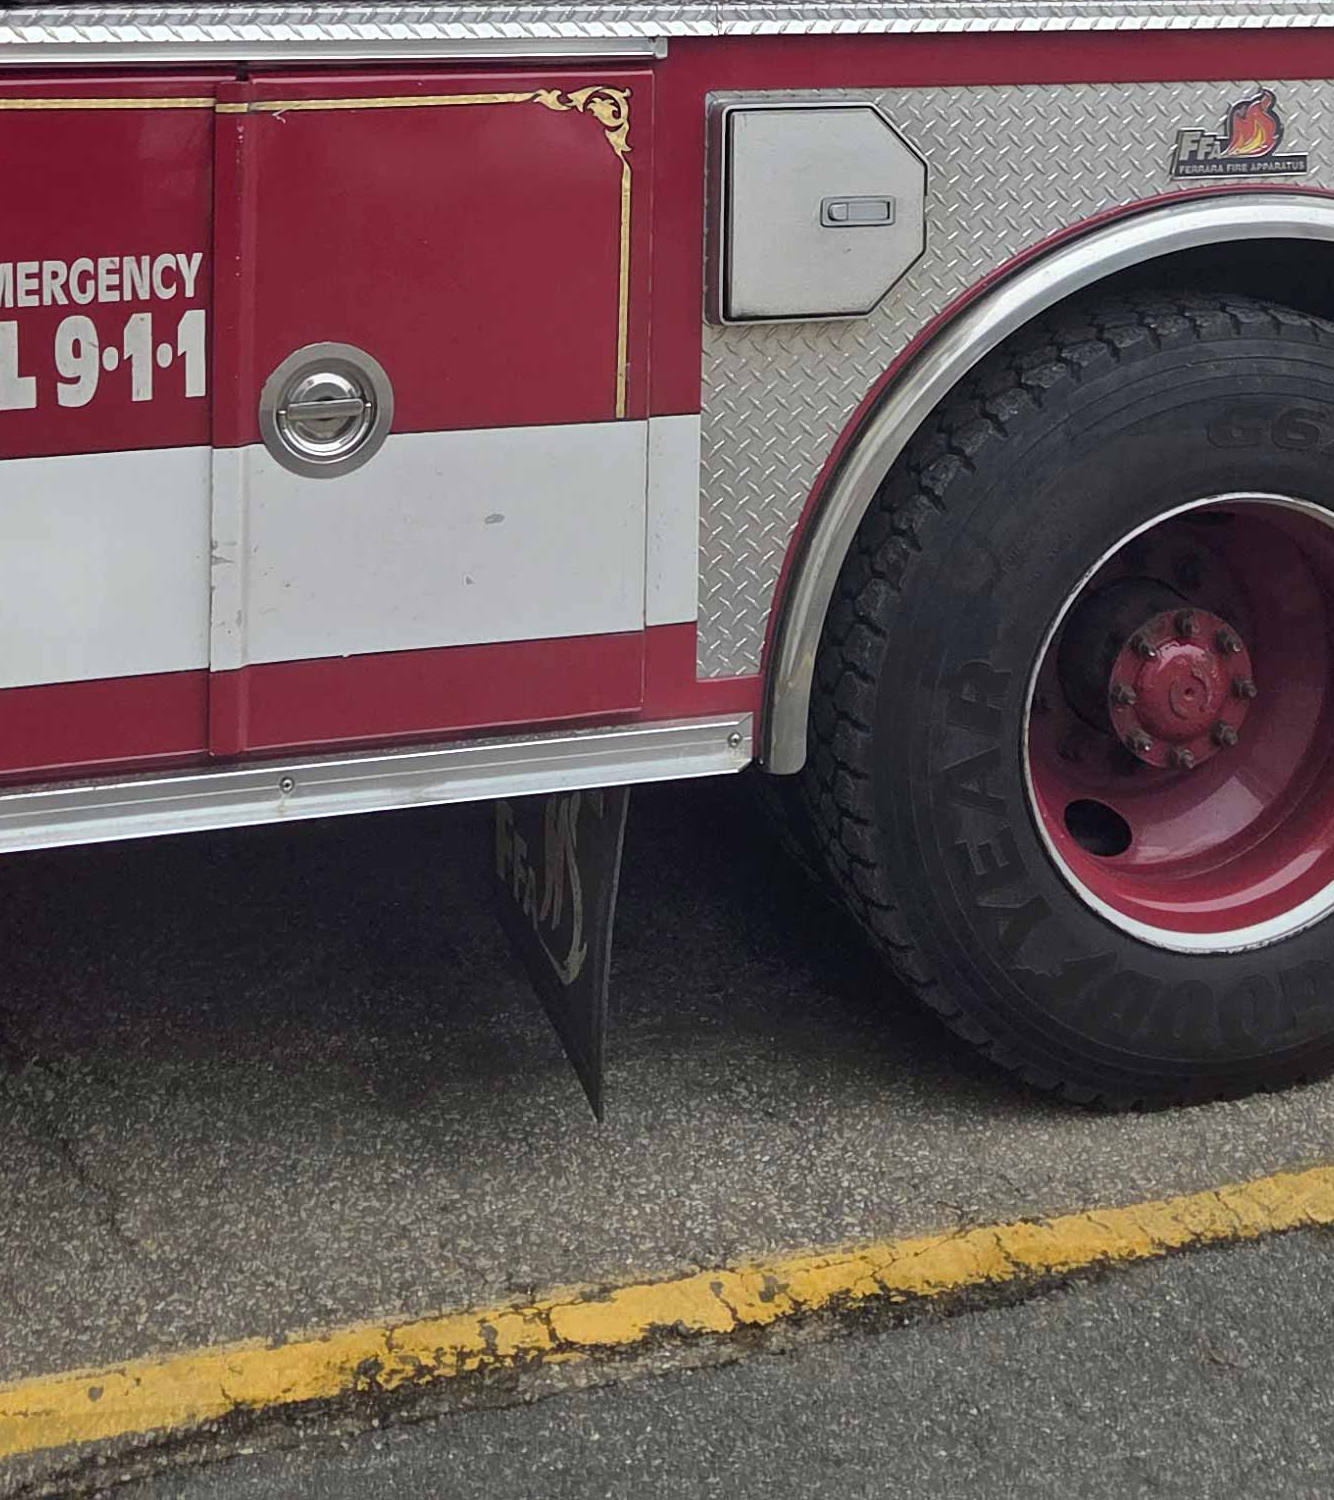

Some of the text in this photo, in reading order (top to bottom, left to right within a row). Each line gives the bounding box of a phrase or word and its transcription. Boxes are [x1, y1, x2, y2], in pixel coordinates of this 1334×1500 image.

[1179, 160, 1306, 175] FERRARA FIRE APPARATUS
